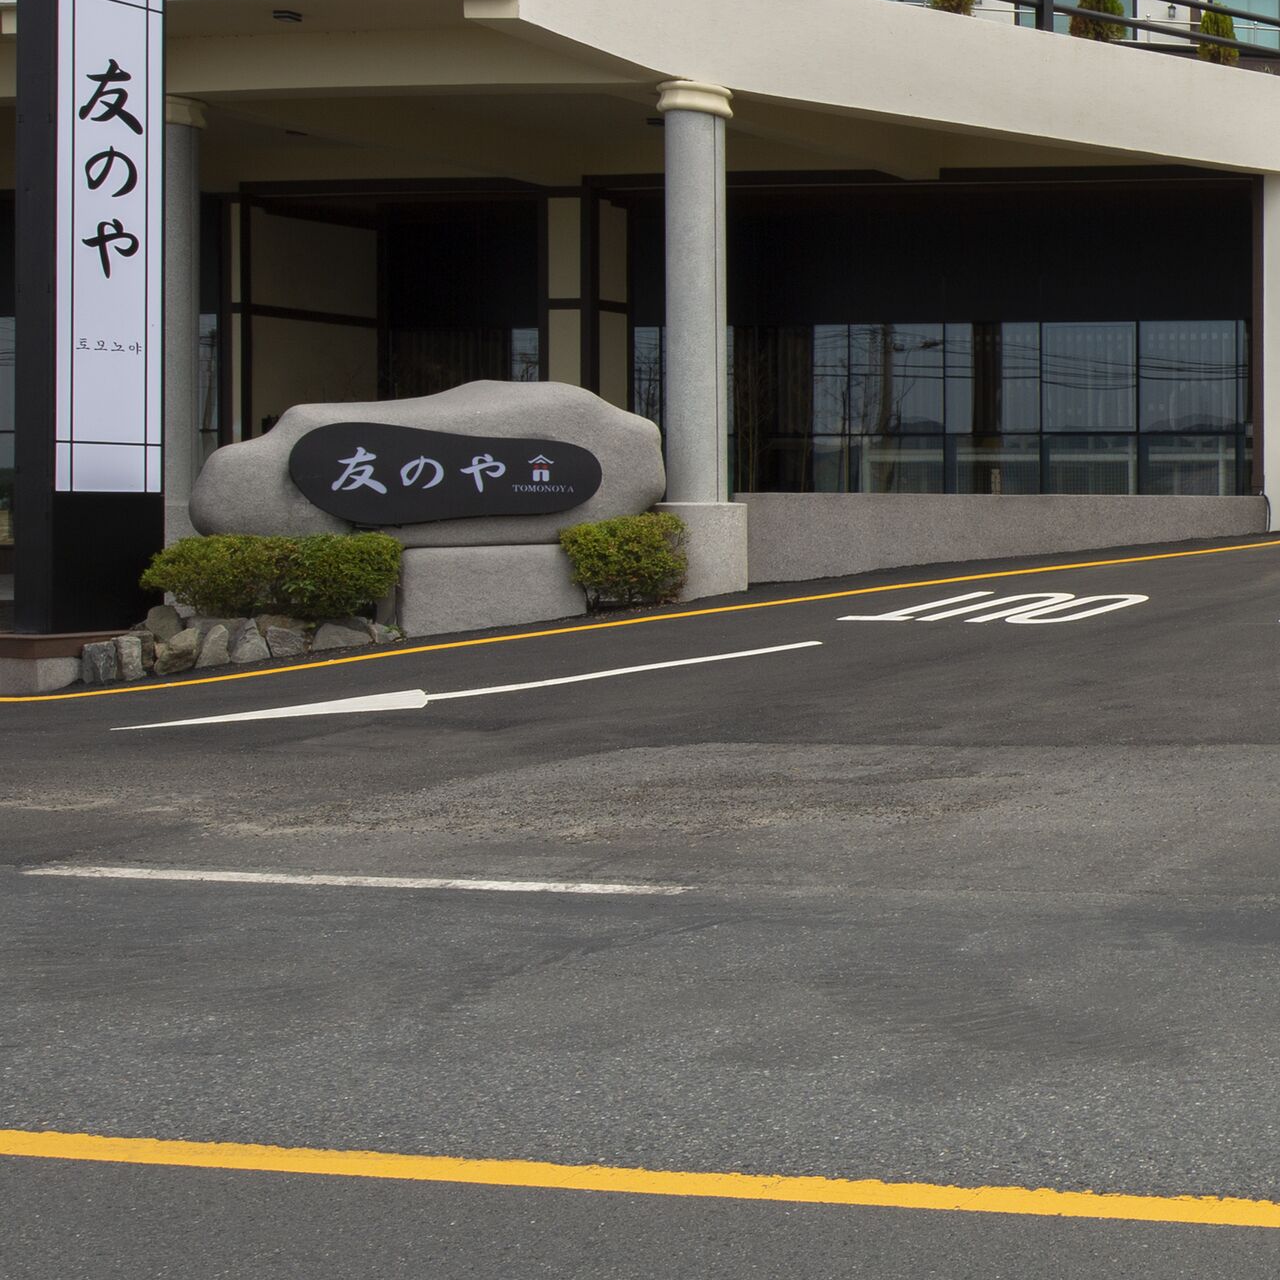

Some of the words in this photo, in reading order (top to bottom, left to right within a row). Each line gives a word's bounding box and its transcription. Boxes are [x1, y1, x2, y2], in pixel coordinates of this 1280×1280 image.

[78, 58, 144, 280] 友のや
[75, 337, 143, 356] 토모노야
[331, 446, 507, 494] 友のや
[512, 484, 575, 493] TOMONOYA
[836, 591, 1150, 624] OUT
